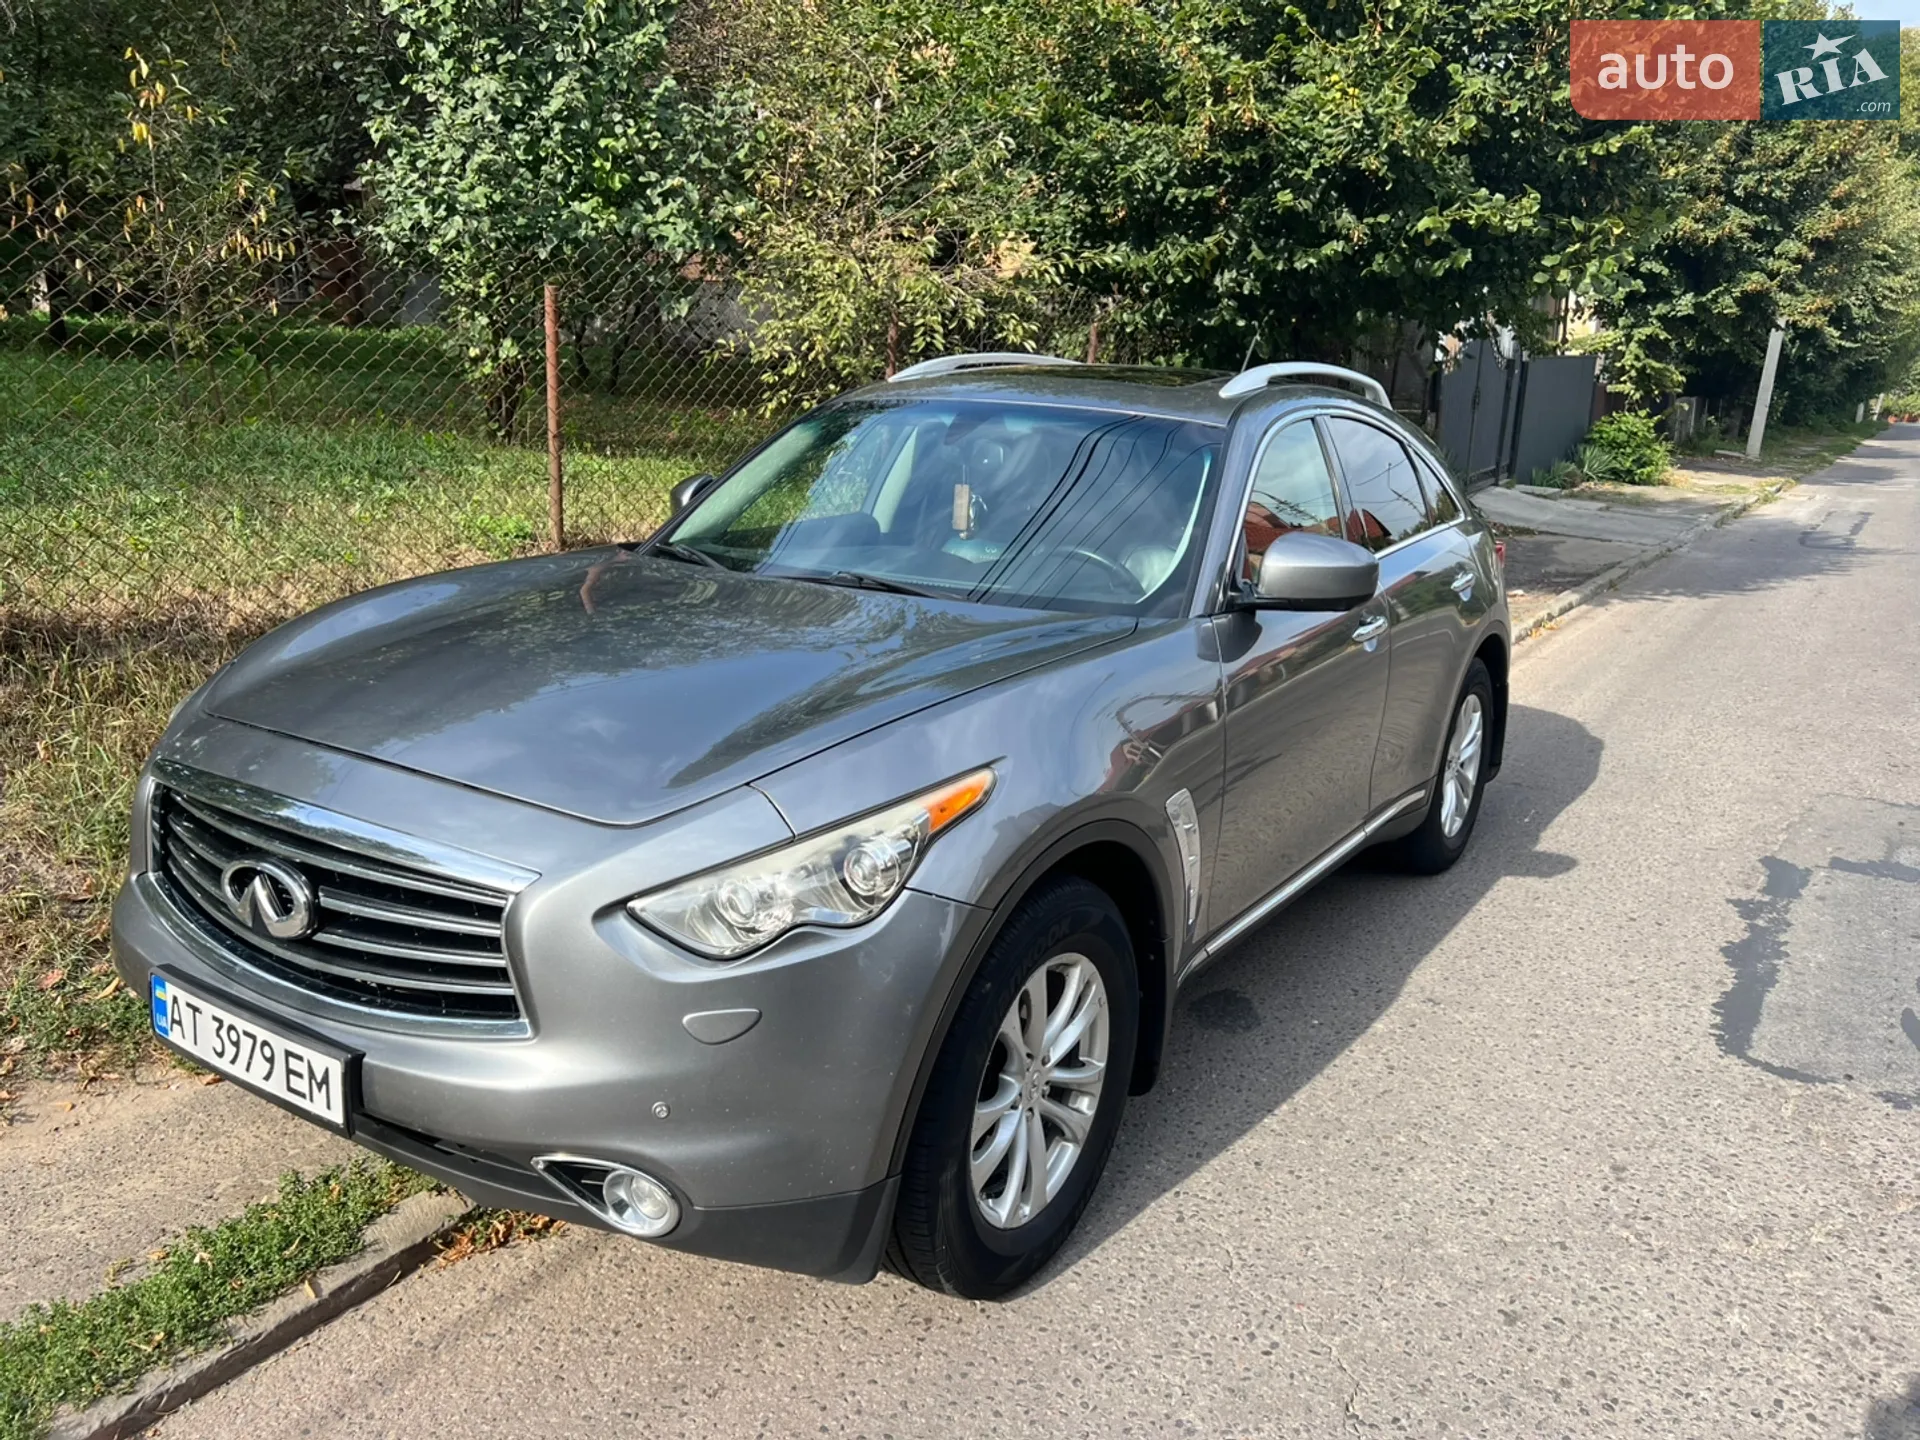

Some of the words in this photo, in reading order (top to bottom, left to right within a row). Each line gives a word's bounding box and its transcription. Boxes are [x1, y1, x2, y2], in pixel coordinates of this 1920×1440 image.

[170, 994, 203, 1047] AT
[211, 1014, 276, 1082] 3979
[284, 1048, 332, 1111] EM
